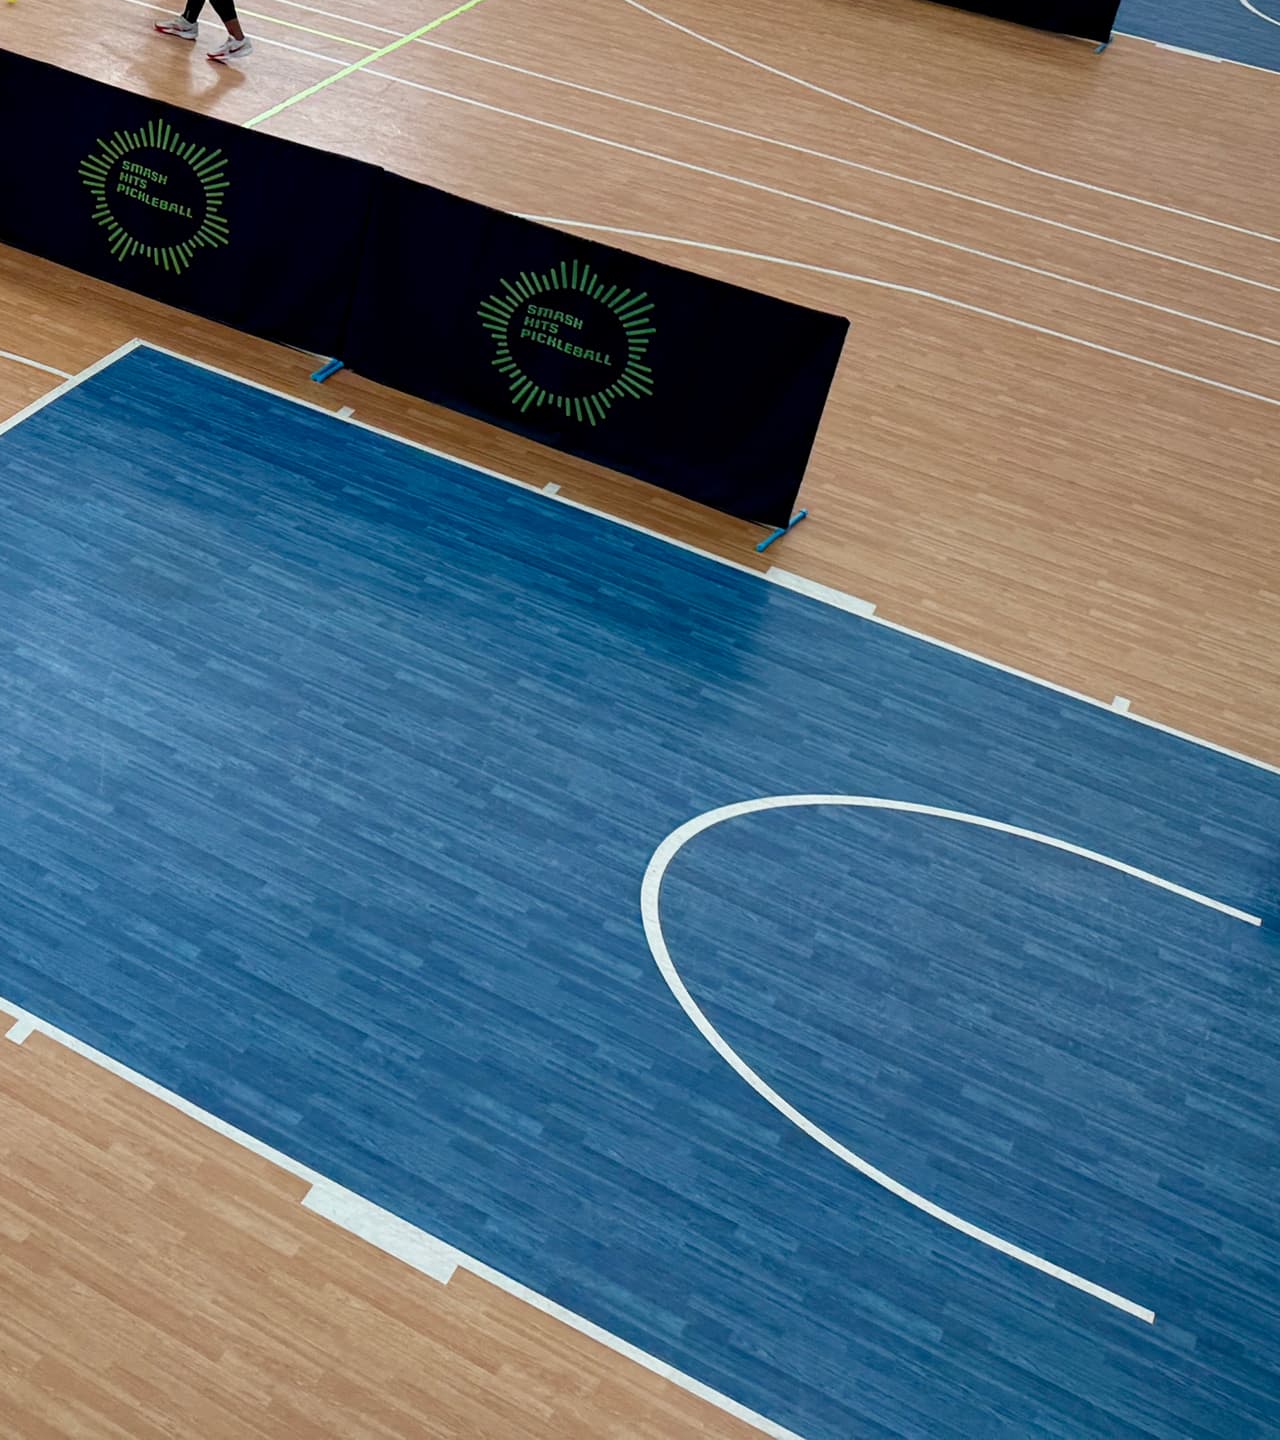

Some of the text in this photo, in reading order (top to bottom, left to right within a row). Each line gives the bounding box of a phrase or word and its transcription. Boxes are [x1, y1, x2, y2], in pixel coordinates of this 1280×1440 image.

[119, 171, 148, 189] HITS
[121, 160, 169, 185] SMASH
[116, 183, 193, 219] PICKLEBALL
[523, 316, 560, 334] HITS
[527, 304, 584, 330] SMASH
[520, 328, 613, 366] PICKLEBALL
